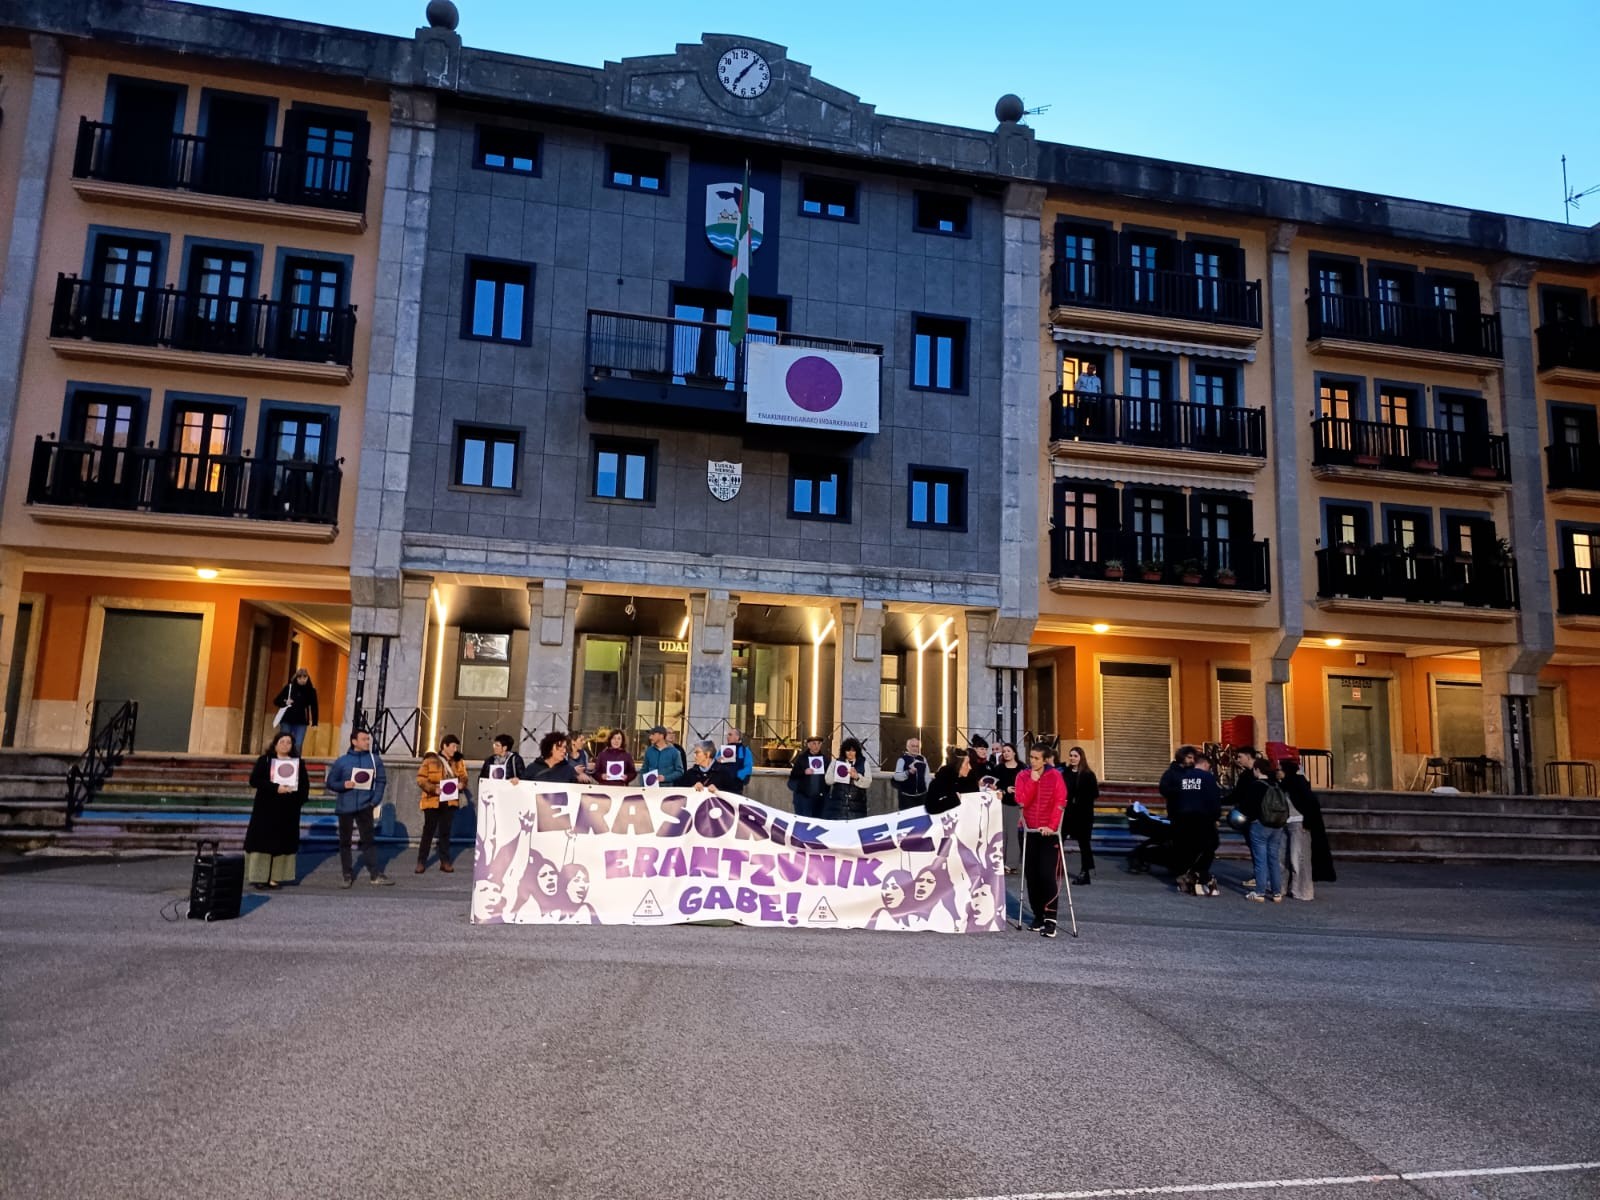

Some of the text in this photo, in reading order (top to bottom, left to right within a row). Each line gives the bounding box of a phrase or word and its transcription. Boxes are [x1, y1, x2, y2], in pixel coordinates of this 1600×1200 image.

[741, 51, 748, 59] 12
[536, 792, 829, 850] ERASORIK
[604, 846, 883, 889] ERANTZUNIK
[679, 886, 802, 925] GABE!
